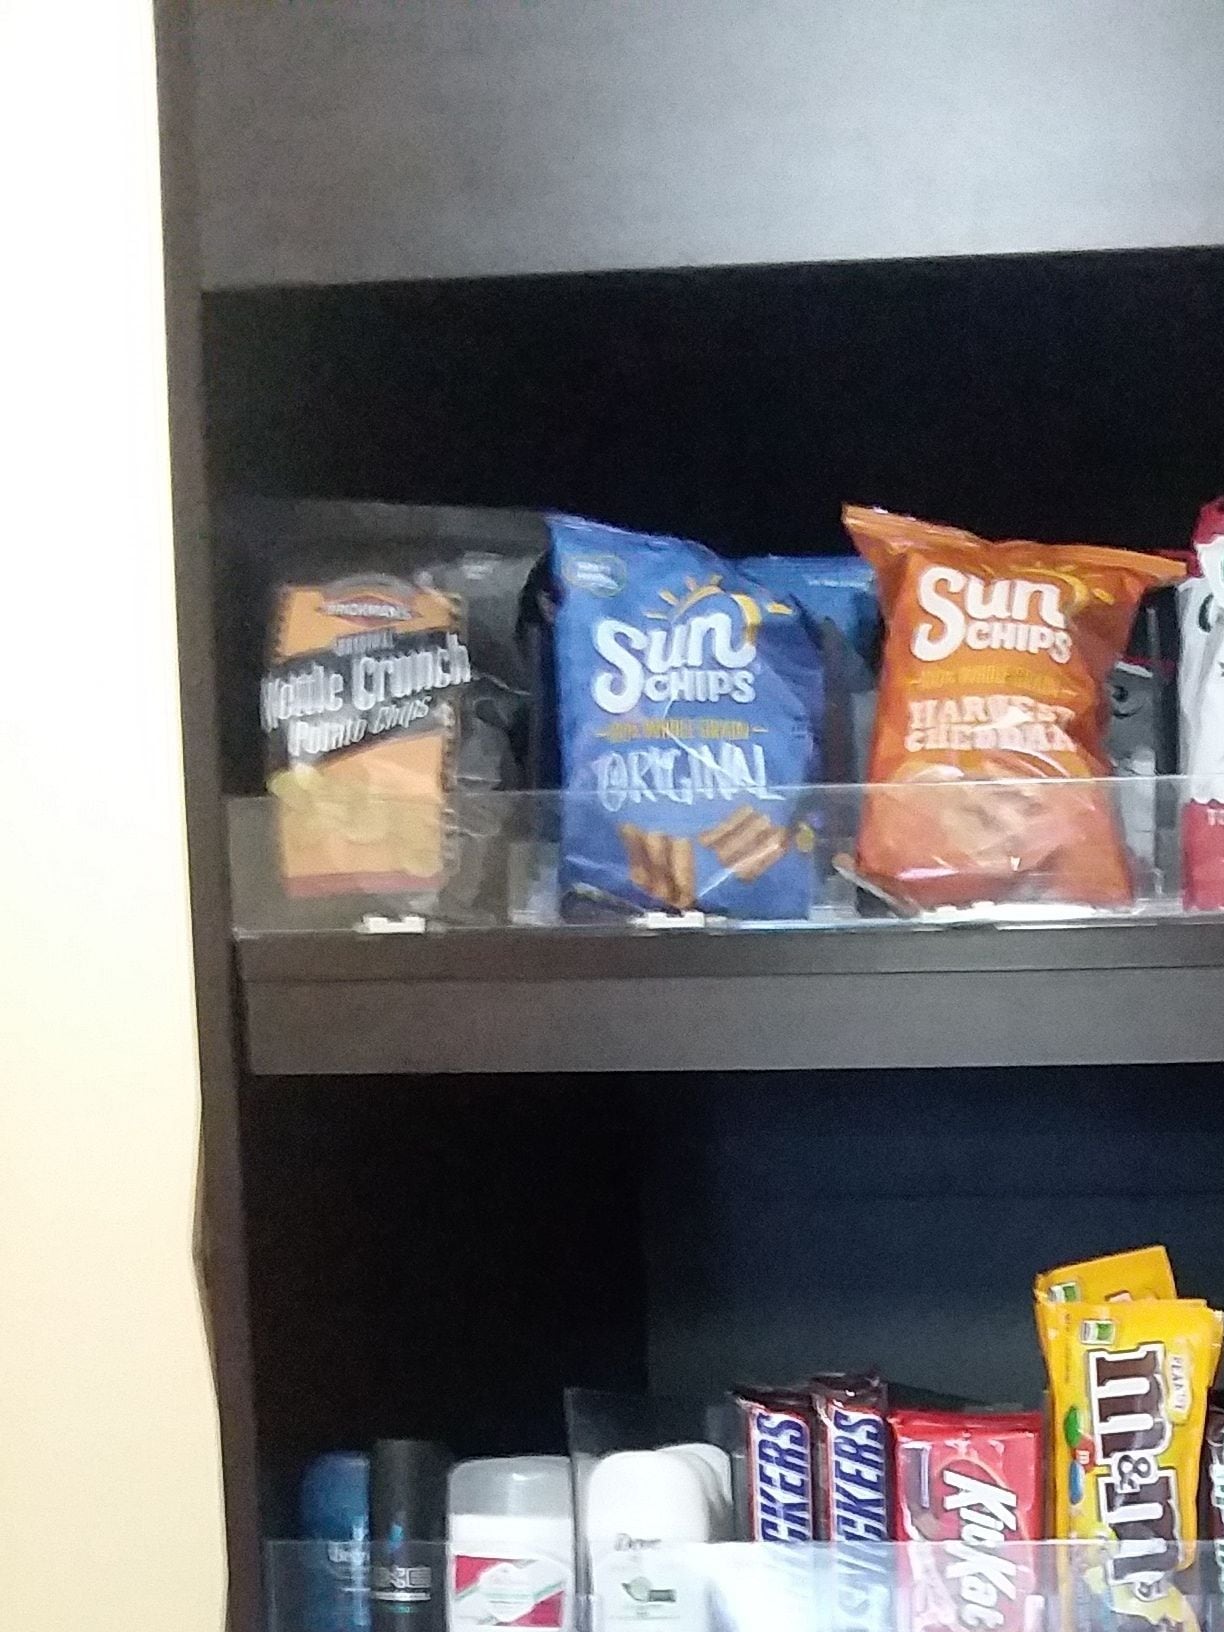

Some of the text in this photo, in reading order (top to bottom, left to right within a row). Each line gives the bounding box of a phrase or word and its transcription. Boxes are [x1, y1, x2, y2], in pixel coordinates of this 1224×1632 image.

[909, 566, 1071, 662] Sun
[965, 621, 1073, 663] CHIPS
[352, 632, 472, 711] Crunch
[591, 612, 757, 714] Sun
[645, 669, 756, 703] CHIPS
[905, 722, 1078, 752] CHEDDAR
[909, 695, 1075, 730] HARVEST
[598, 742, 784, 812] ORIGINAL
